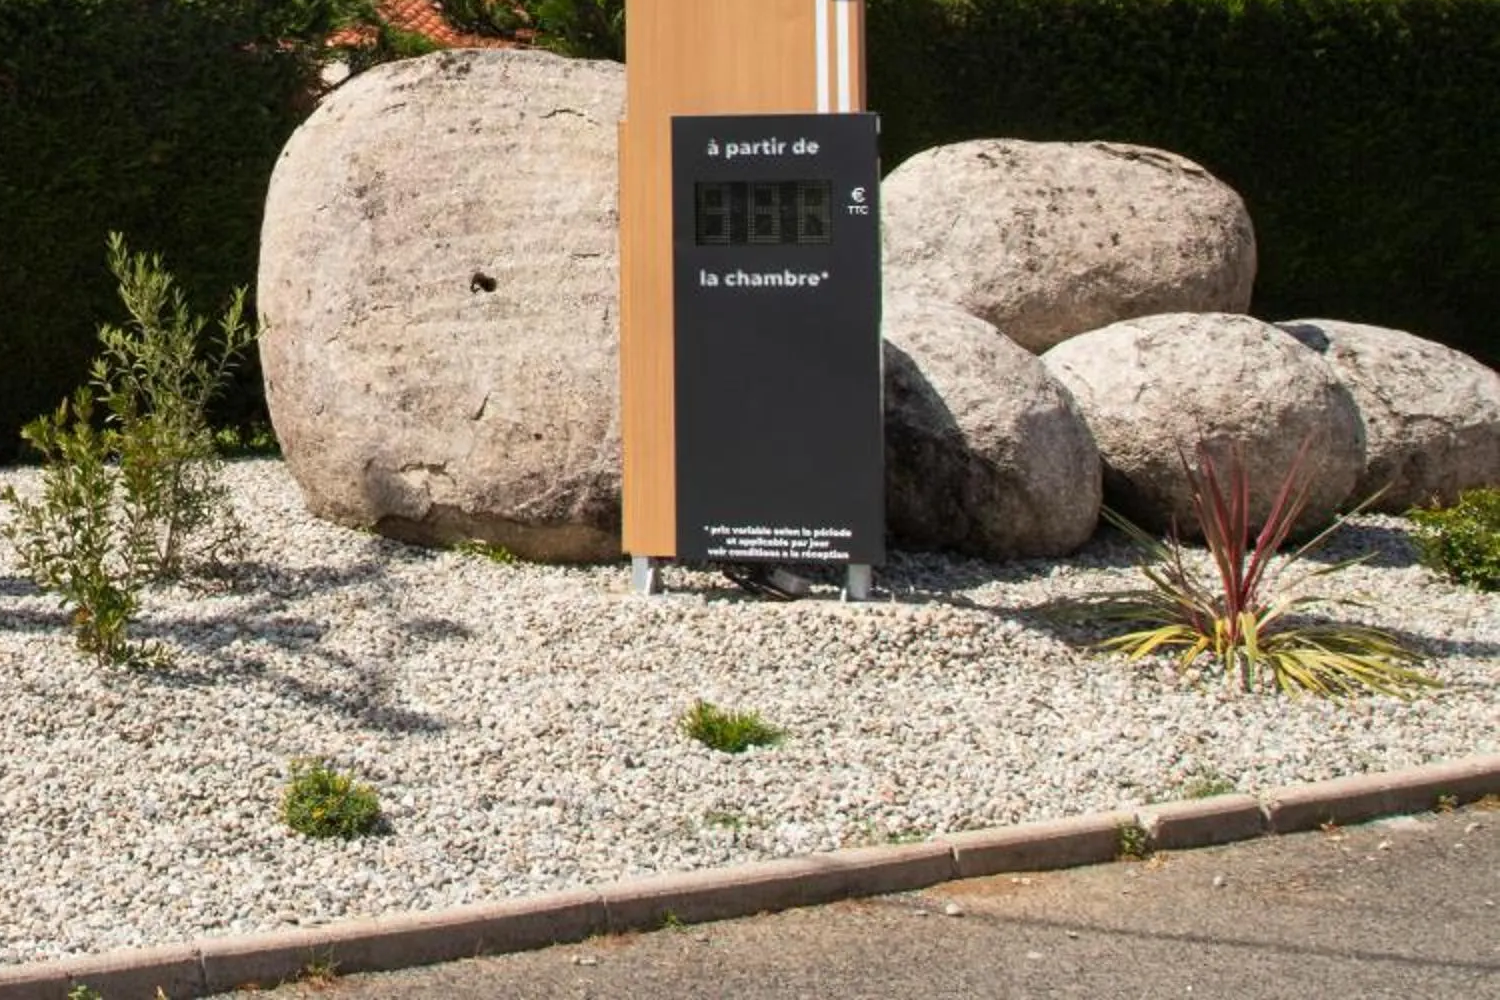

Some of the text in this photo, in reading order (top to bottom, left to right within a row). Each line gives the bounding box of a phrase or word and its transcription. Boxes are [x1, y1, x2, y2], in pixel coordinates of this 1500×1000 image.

[725, 136, 786, 159] partir
[792, 138, 820, 155] de
[851, 187, 866, 203] €
[847, 205, 869, 215] TTC
[700, 269, 719, 286] la
